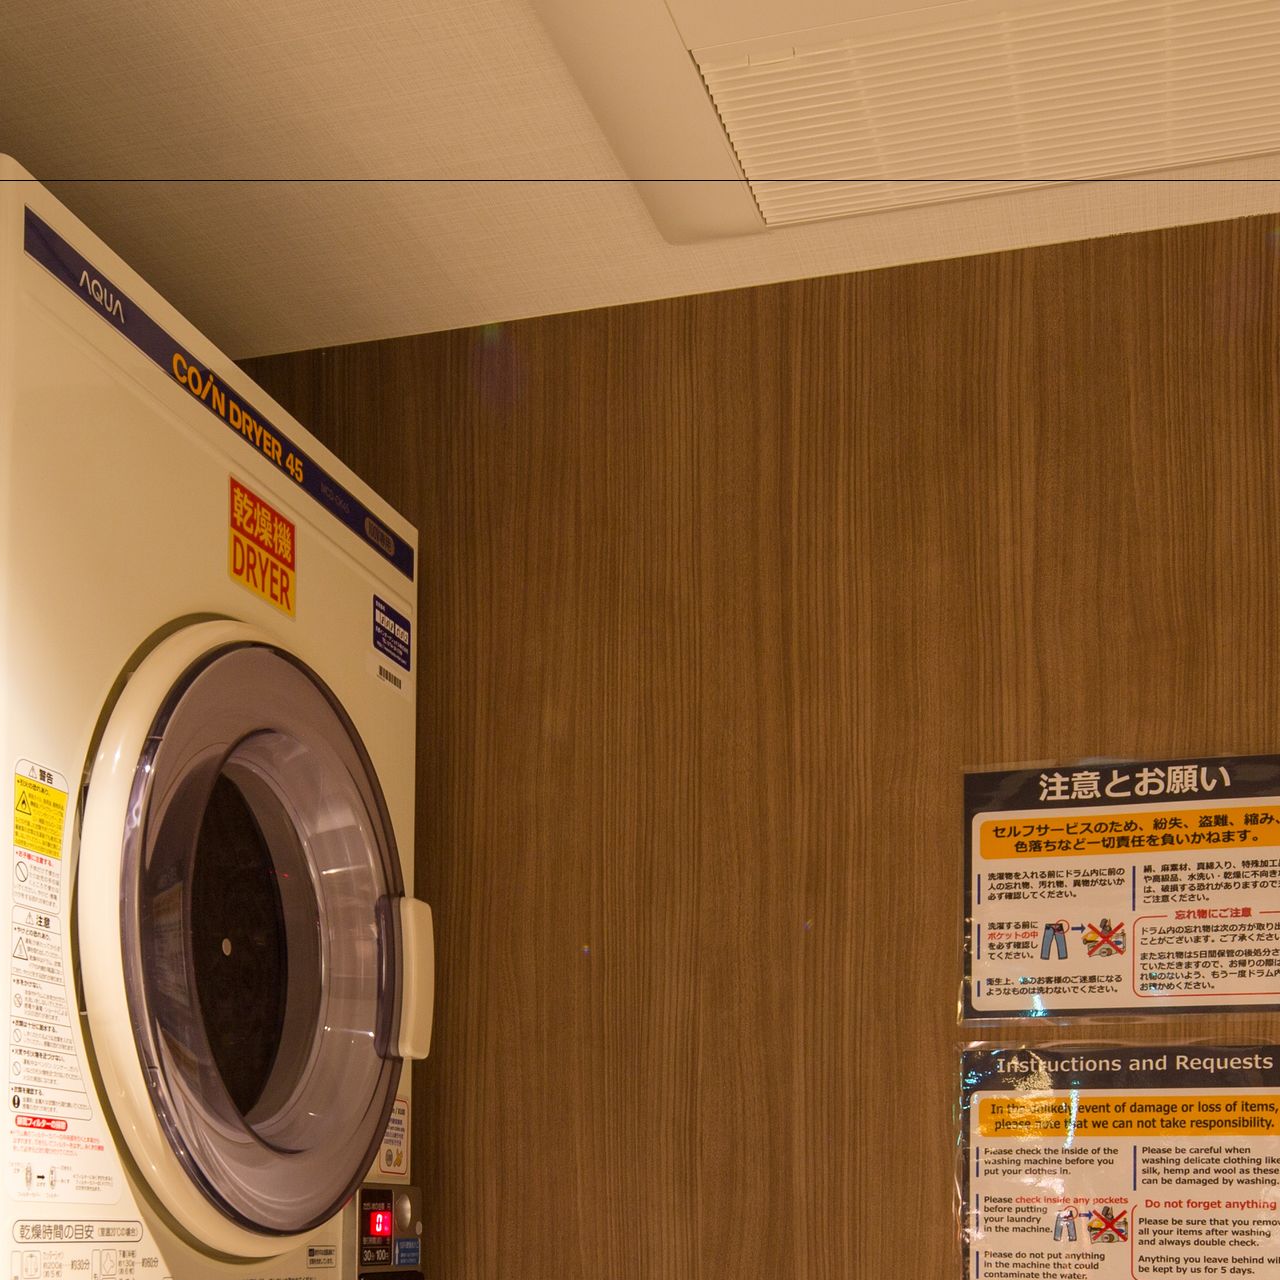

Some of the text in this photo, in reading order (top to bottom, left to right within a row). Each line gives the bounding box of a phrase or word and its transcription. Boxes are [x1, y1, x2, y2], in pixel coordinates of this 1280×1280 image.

[80, 270, 125, 324] AQUA
[230, 400, 281, 465] DRYER
[286, 453, 303, 483] 45
[234, 488, 291, 562] 乾燥機
[233, 535, 291, 610] DRYER
[1038, 764, 1231, 802] 注意とお願い
[1014, 830, 1259, 853] 色落ちなど一切責任を負いかねます。
[988, 868, 1125, 880] 洗濯物を入れる前にドラム内に前の
[988, 890, 1077, 901] 必ず確認してください。
[1144, 895, 1210, 903] ご注意ください。
[1175, 907, 1252, 920] 忘れ物にご注意
[988, 921, 1038, 930] 洗濯する前に
[988, 931, 1038, 939] ポケットの中
[988, 942, 1038, 950] を必ず確認し
[988, 952, 1034, 960] てください。
[997, 1054, 1273, 1073] Instructions and Requests
[991, 1104, 1003, 1114] In
[1080, 1104, 1109, 1113] event
[1114, 1103, 1126, 1113] of
[1130, 1102, 1177, 1115] damage
[1182, 1104, 1194, 1112] or
[1198, 1102, 1221, 1112] loss
[1226, 1101, 1237, 1111] of
[1241, 1102, 1278, 1113] items,
[995, 1119, 1030, 1131] please
[1112, 1120, 1133, 1128] can
[1137, 1119, 1156, 1128] not
[1160, 1118, 1186, 1127] take
[1190, 1117, 1274, 1130] responsibility.
[1142, 1157, 1180, 1166] washing
[1223, 1157, 1261, 1166] clothing
[1142, 1167, 1160, 1175] silk,
[1164, 1167, 1189, 1176] hemp
[1175, 1177, 1219, 1186] damaged
[1222, 1177, 1233, 1186] by
[1237, 1177, 1279, 1186] washing.
[1093, 1197, 1128, 1206] pockets
[1145, 1200, 1160, 1208] Do
[1164, 1200, 1183, 1208] not
[1187, 1200, 1222, 1210] forget
[1225, 1200, 1277, 1211] anything
[20, 1224, 94, 1240] 乾燥時間の目安
